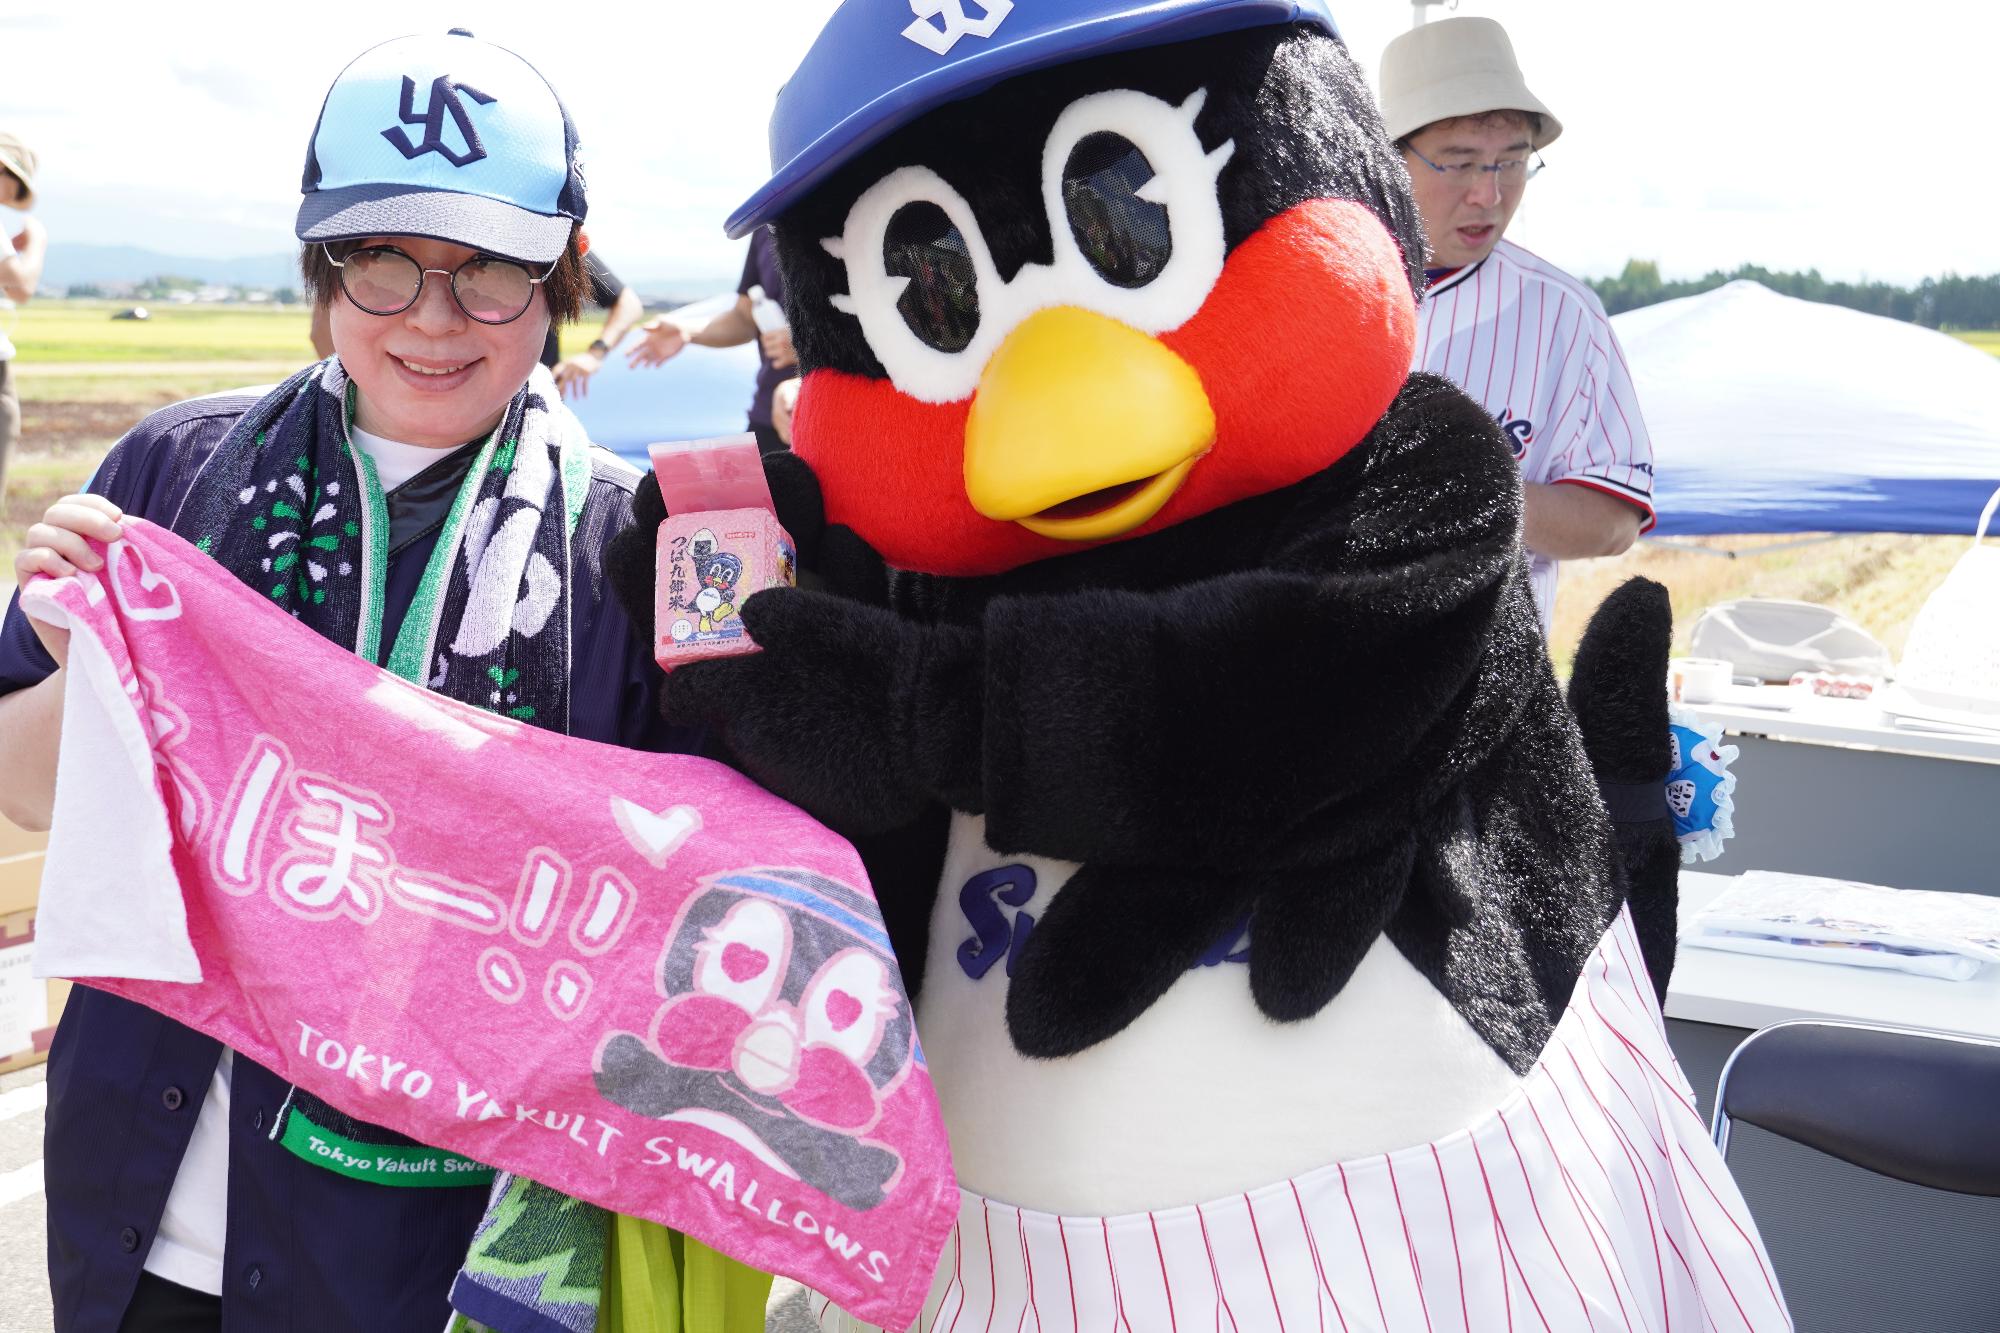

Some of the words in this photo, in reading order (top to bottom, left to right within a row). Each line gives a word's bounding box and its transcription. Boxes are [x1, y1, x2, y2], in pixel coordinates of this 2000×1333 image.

[296, 1019, 432, 1099] TOKYO
[642, 1136, 890, 1283] SWALLOWS
[308, 1135, 372, 1169] Tokyo
[376, 1157, 437, 1173] Yakult
[443, 1158, 497, 1173] Swa
